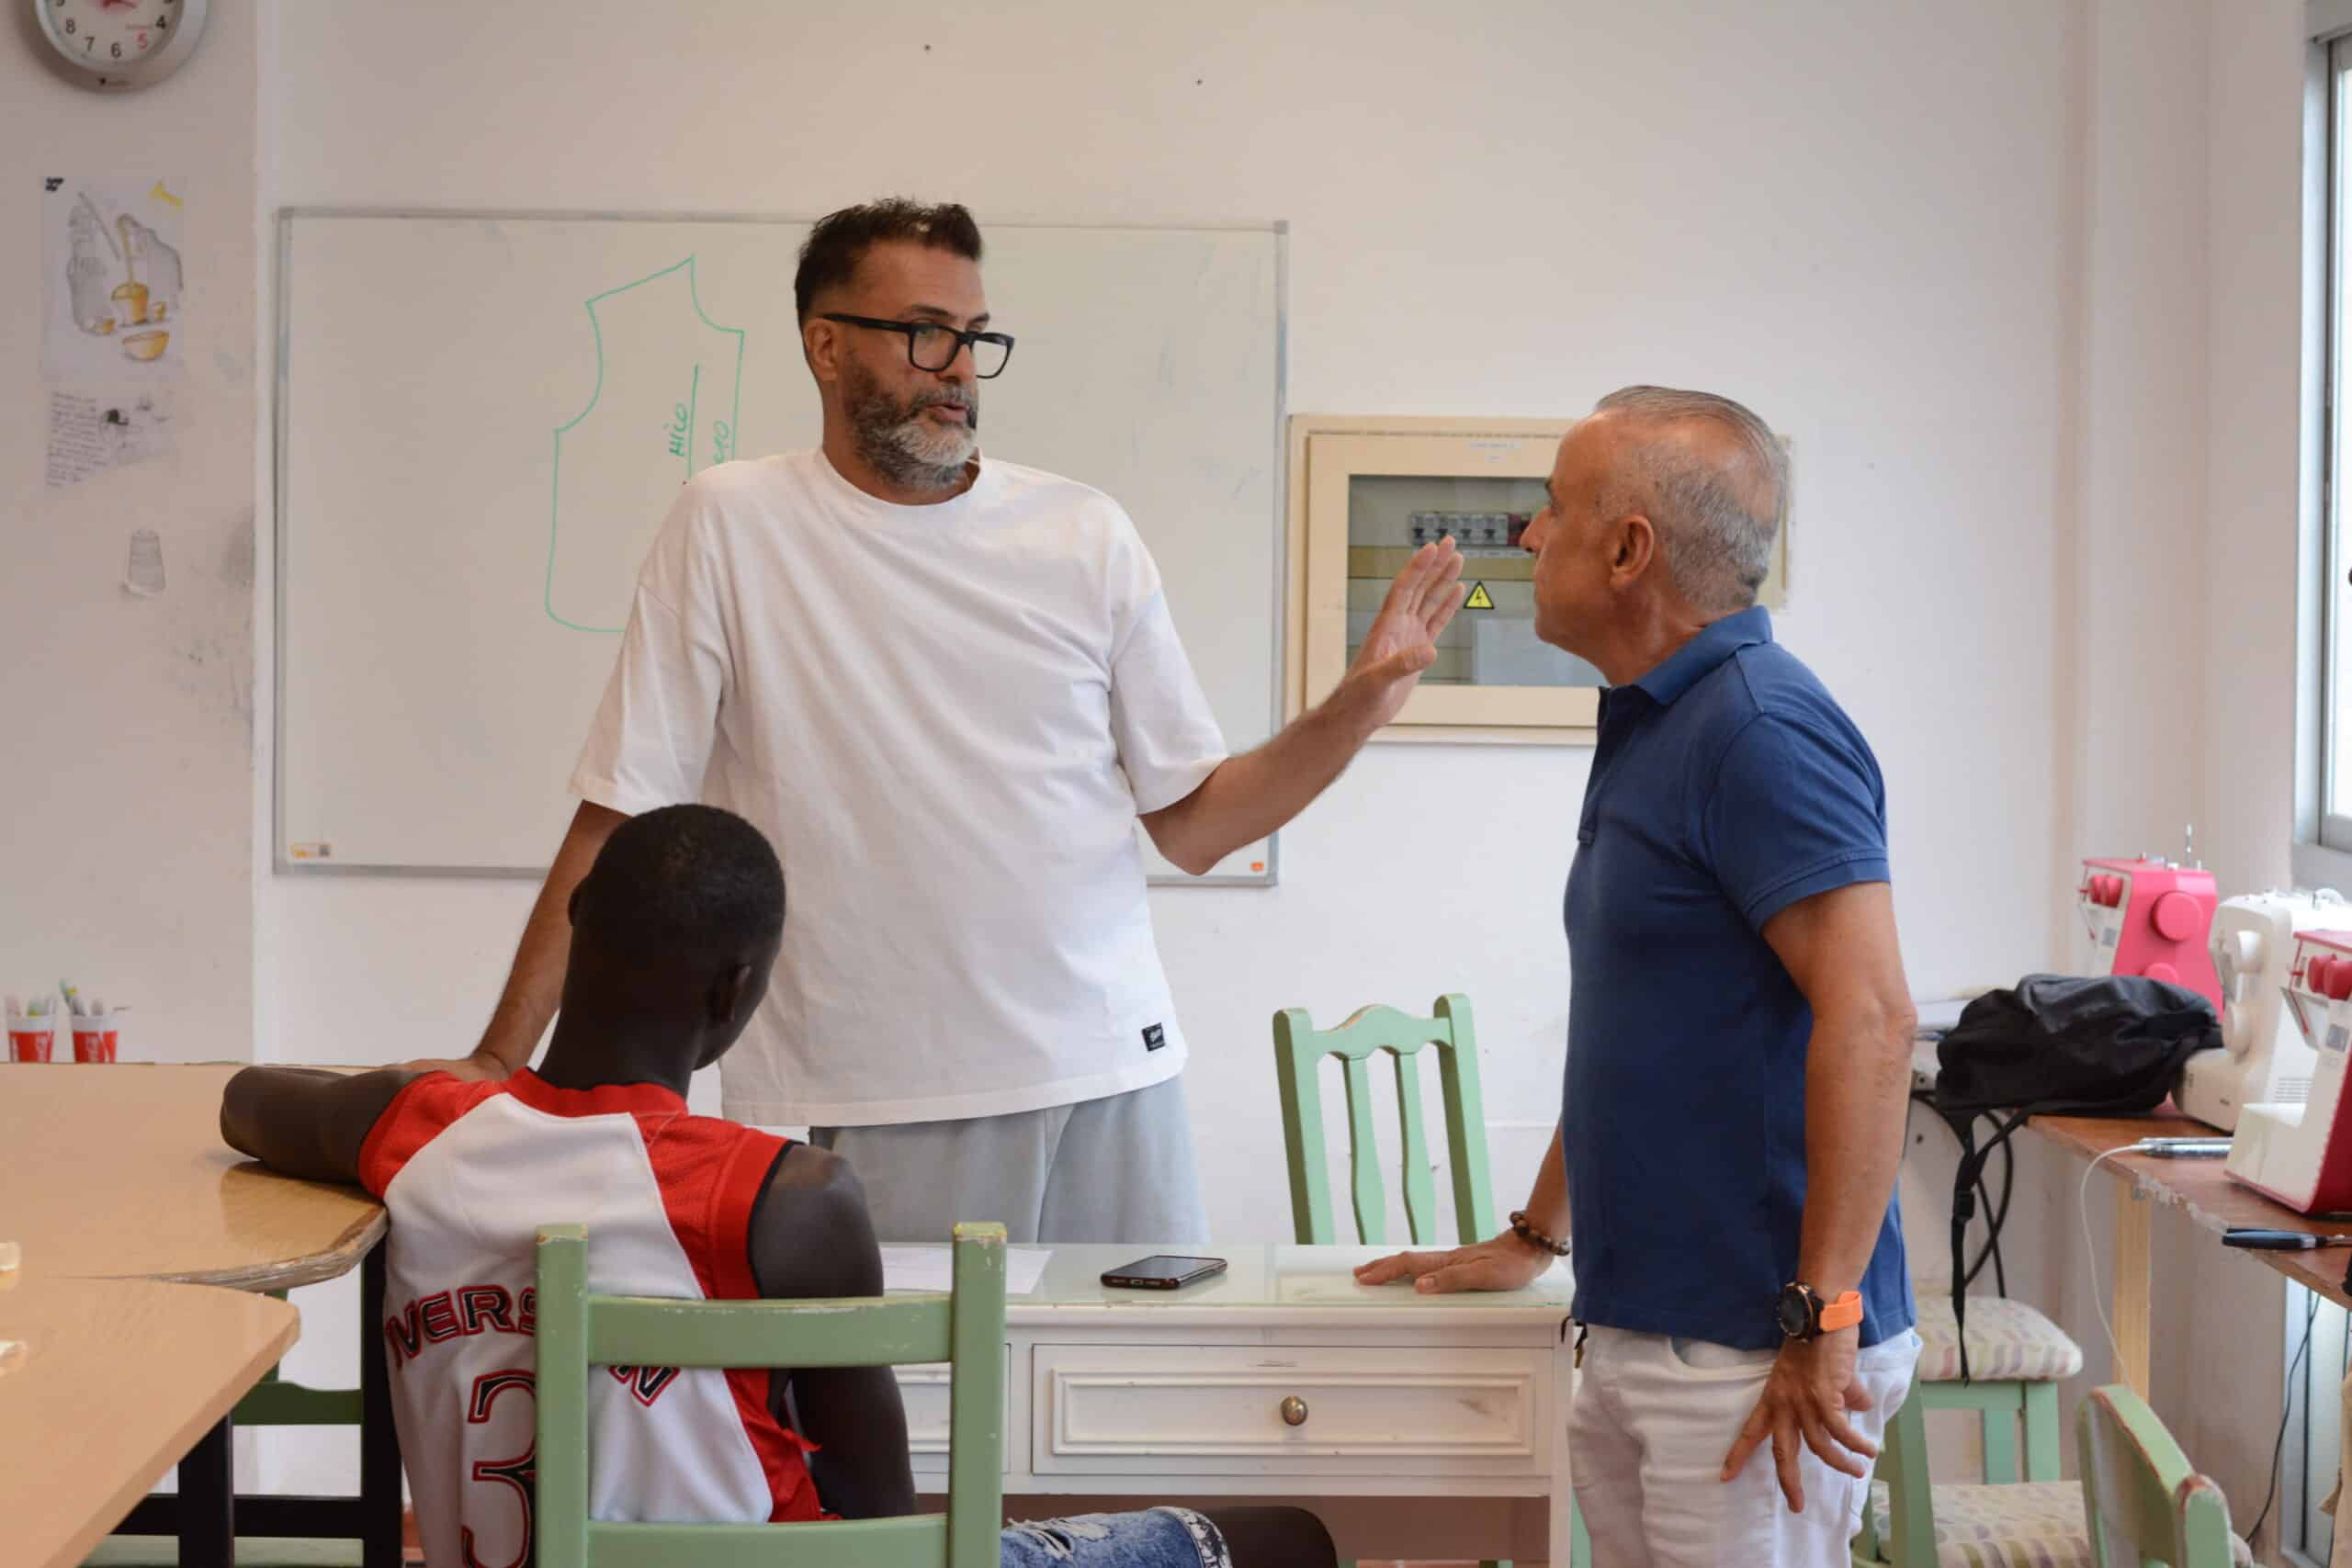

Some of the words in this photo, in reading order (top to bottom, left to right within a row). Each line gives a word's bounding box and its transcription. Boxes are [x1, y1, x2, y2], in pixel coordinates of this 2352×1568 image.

[65, 18, 76, 35] 8
[155, 15, 166, 30] 4
[84, 36, 96, 51] 7
[136, 31, 148, 50] 5
[110, 42, 122, 59] 6
[461, 1369, 537, 1568] 3
